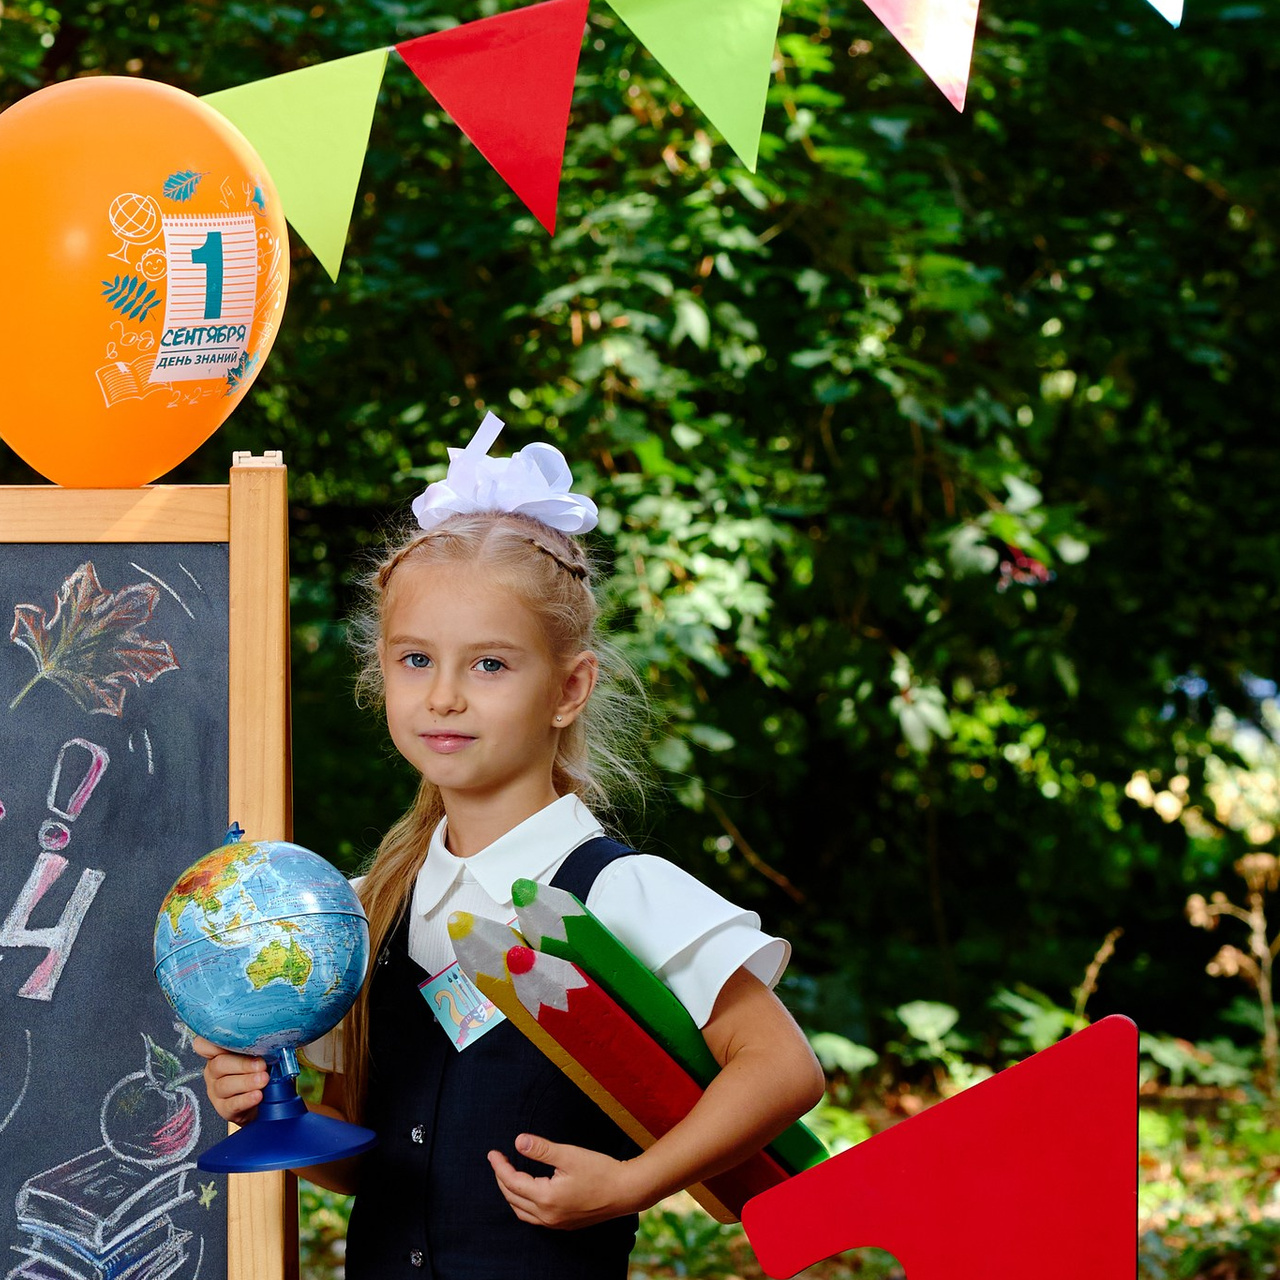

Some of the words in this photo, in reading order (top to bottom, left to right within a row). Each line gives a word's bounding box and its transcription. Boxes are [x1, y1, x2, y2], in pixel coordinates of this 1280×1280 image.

[191, 231, 224, 320] 1
[160, 324, 247, 347] СЕНТЯБРЯ
[155, 355, 193, 370] ДЕНЬ
[194, 351, 238, 365] ЗНАНИЙ
